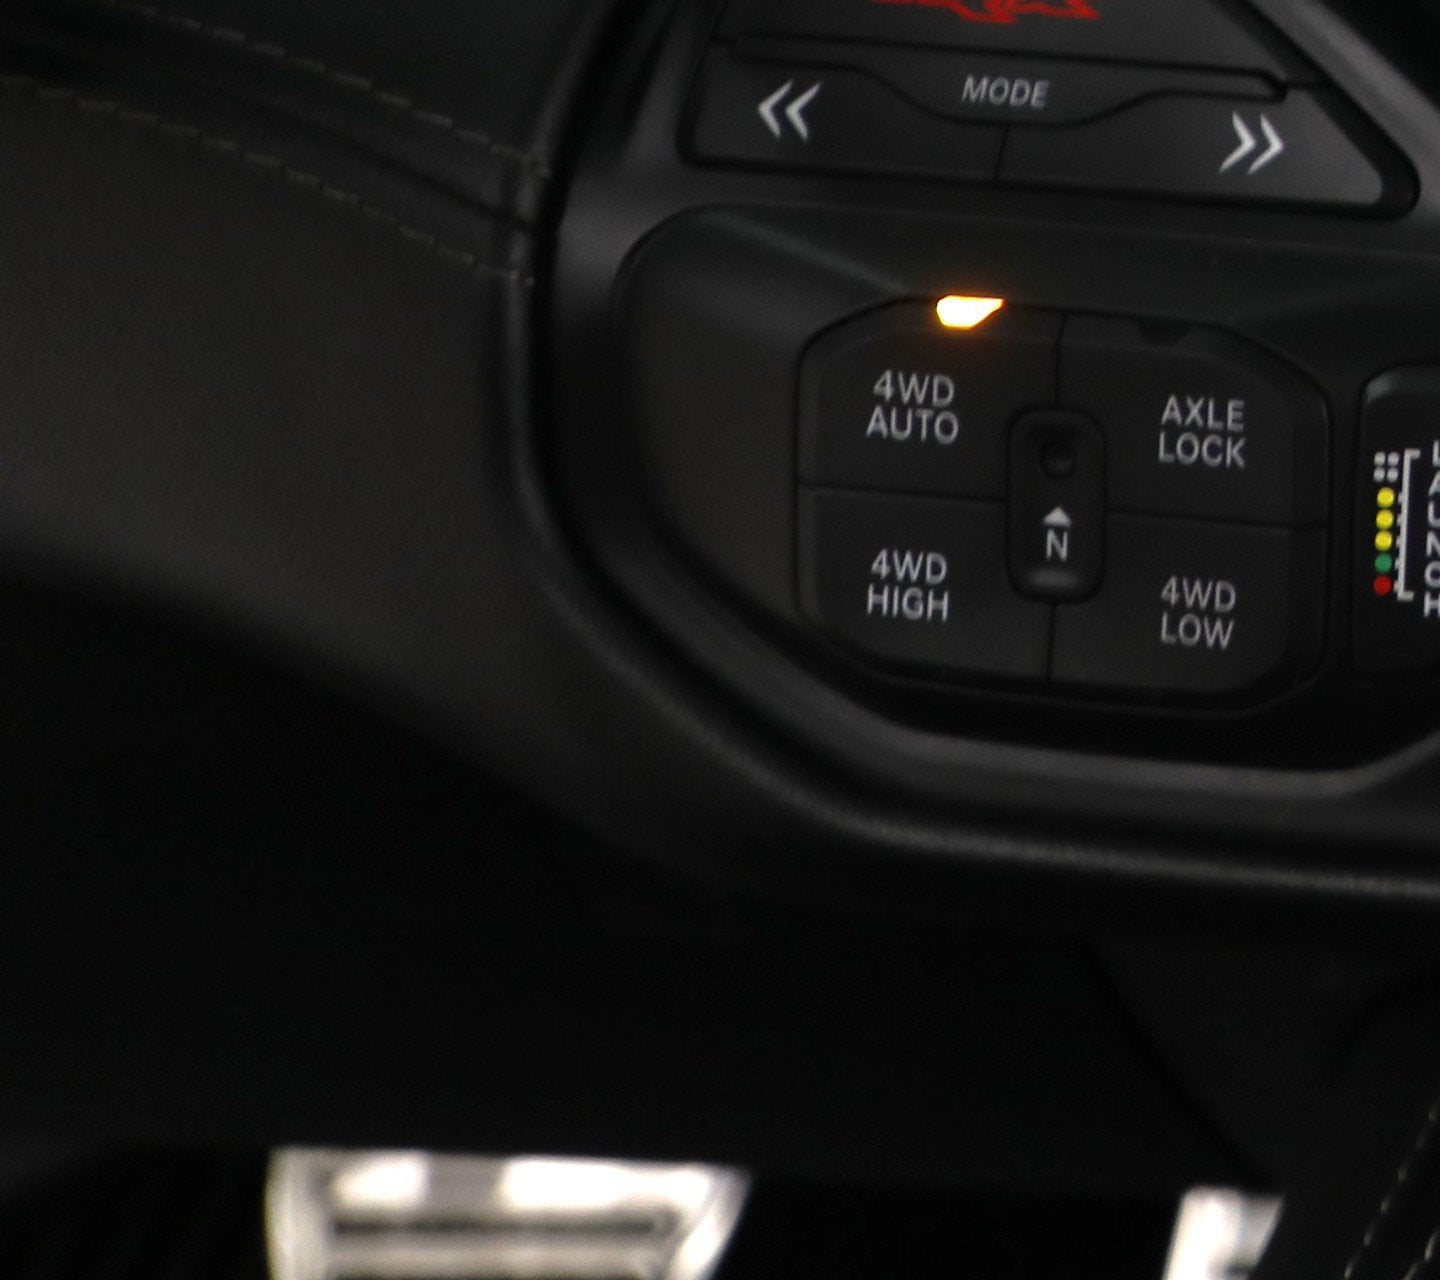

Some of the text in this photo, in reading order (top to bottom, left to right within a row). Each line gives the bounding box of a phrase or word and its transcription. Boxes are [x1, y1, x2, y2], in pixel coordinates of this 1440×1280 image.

[961, 73, 1050, 111] MODE
[872, 369, 957, 406] 4WD
[866, 406, 961, 444] AUTO
[1160, 395, 1246, 432] AXLE
[1157, 431, 1246, 468] LOCK
[1045, 526, 1069, 561] N
[869, 550, 949, 587] 4WD
[867, 585, 951, 623] HIGH
[1160, 576, 1237, 612] 4WD
[1159, 611, 1235, 649] LOW
